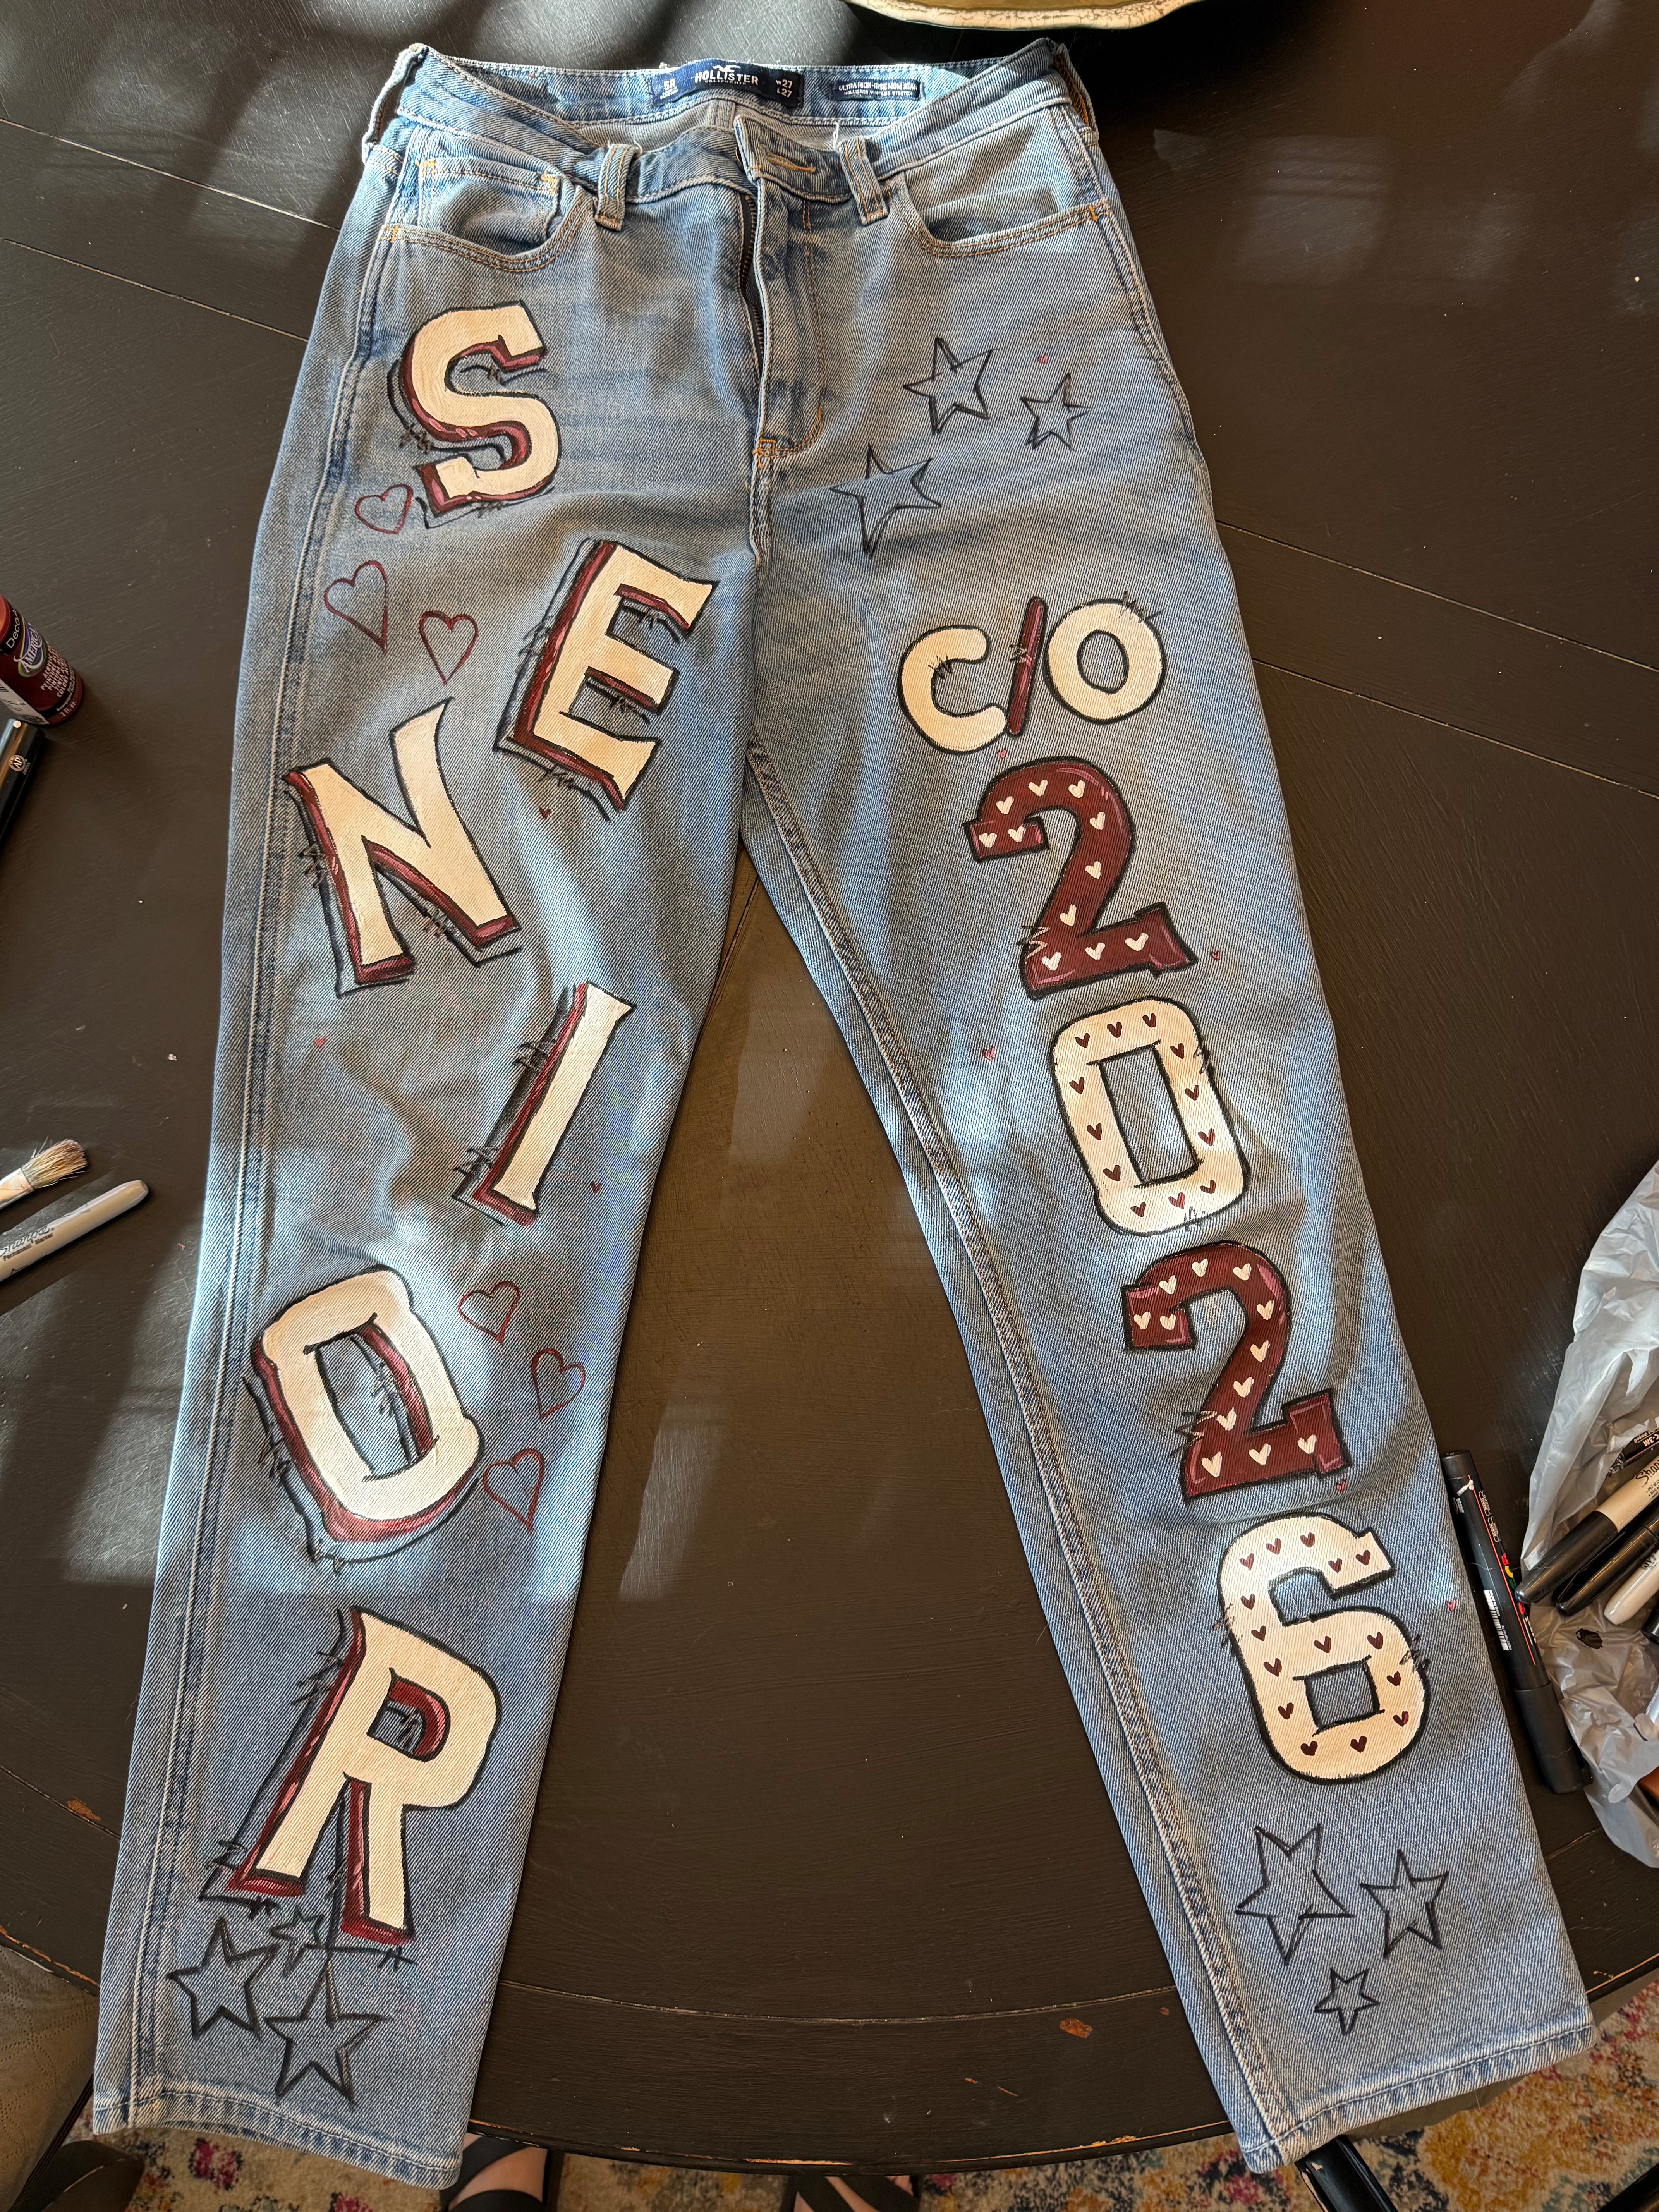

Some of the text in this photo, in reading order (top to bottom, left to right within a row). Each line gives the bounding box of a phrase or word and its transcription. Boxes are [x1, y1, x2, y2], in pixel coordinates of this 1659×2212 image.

[694, 70, 759, 85] HOLLISTER
[663, 78, 676, 91] 5R
[776, 79, 793, 89] W27
[838, 82, 857, 91] ULTRA
[777, 88, 792, 98] L27
[963, 756, 1429, 1784] 2026
[1643, 1434, 1659, 1446] C-3M
